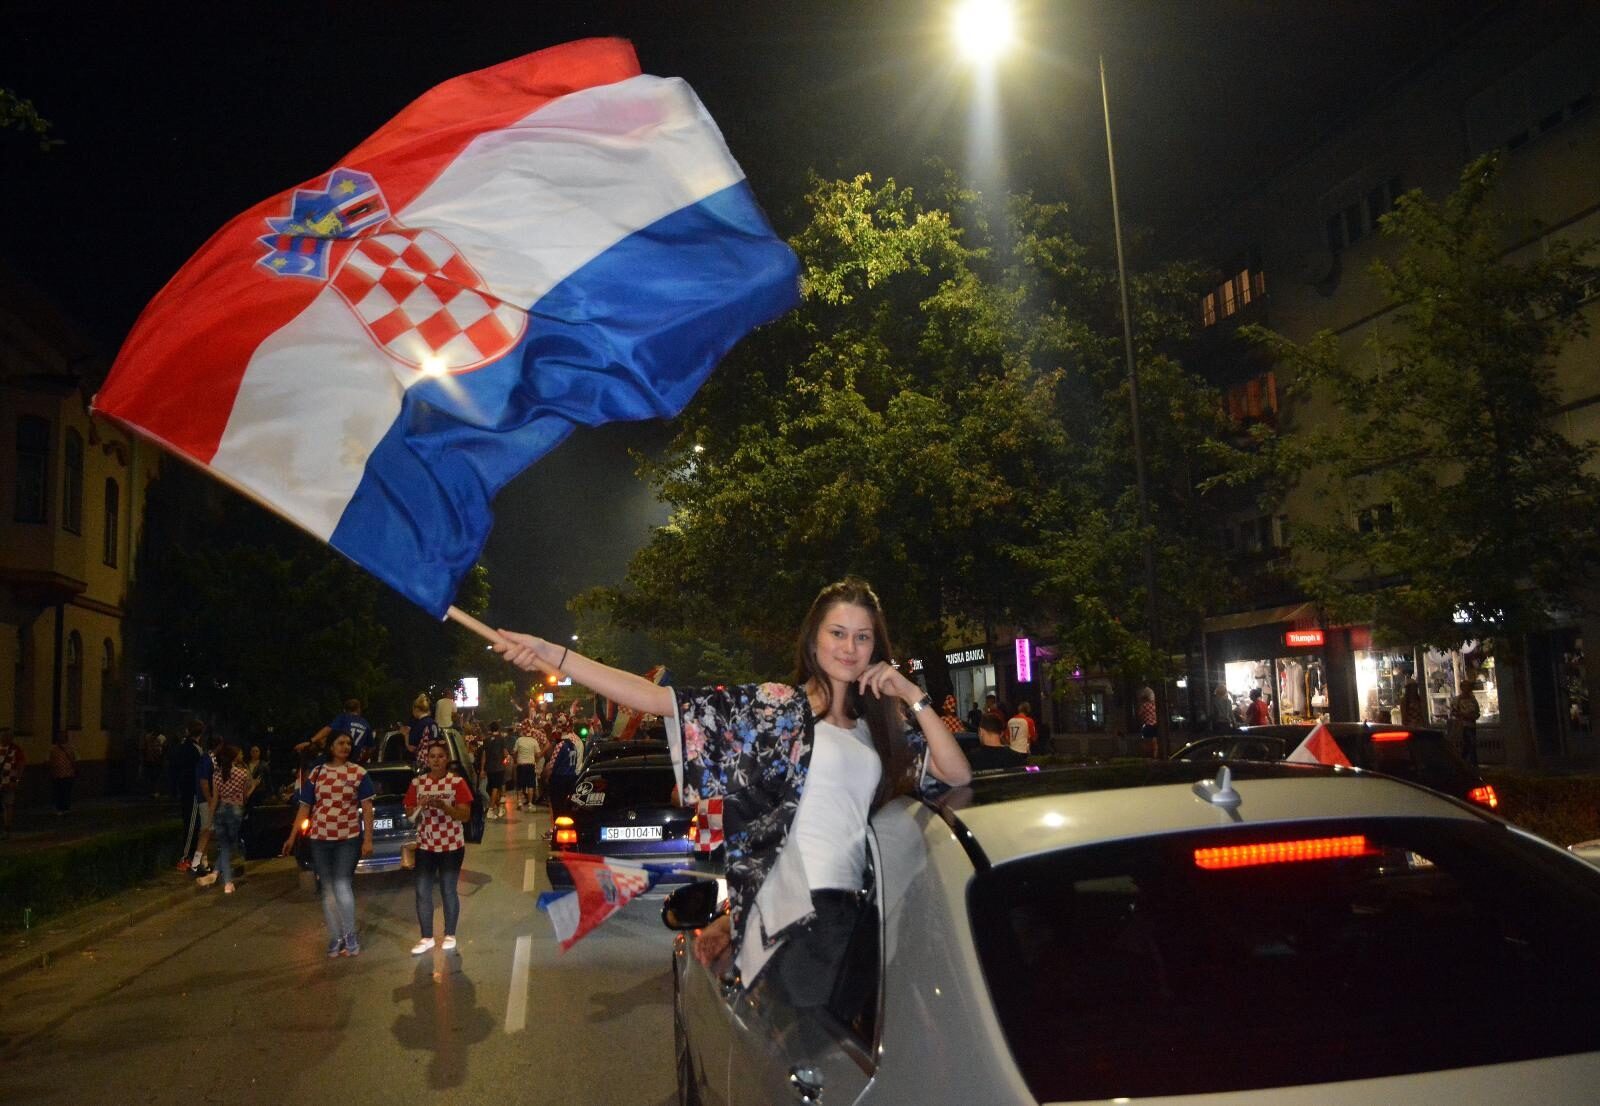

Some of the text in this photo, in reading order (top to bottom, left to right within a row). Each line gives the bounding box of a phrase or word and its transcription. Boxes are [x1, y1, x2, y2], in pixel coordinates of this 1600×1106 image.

[1291, 634, 1316, 644] Triumph
[965, 649, 984, 661] BANKA
[608, 828, 619, 839] SB
